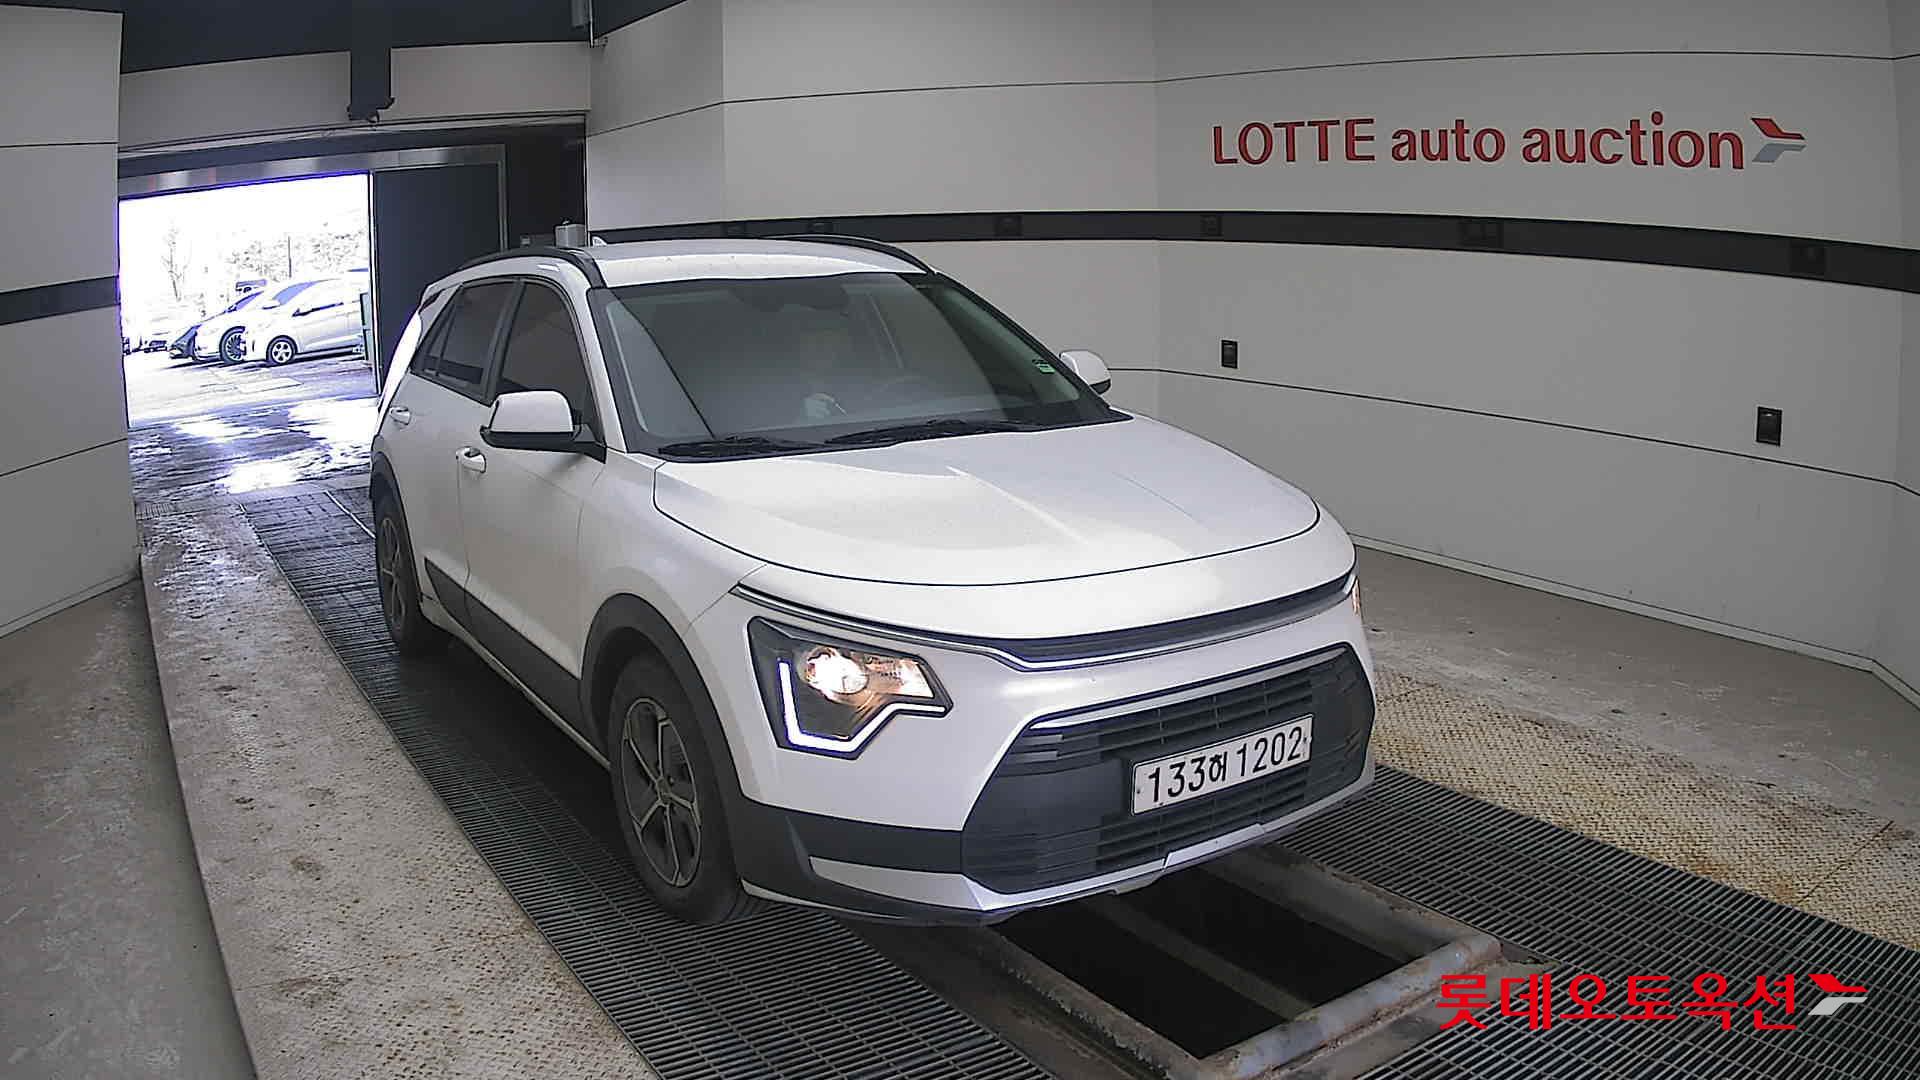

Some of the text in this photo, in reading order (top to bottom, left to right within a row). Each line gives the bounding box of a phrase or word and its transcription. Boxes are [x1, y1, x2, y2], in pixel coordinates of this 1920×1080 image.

[1213, 111, 1745, 170] LOTTE auto auction
[1148, 726, 1302, 802] 133허 1202
